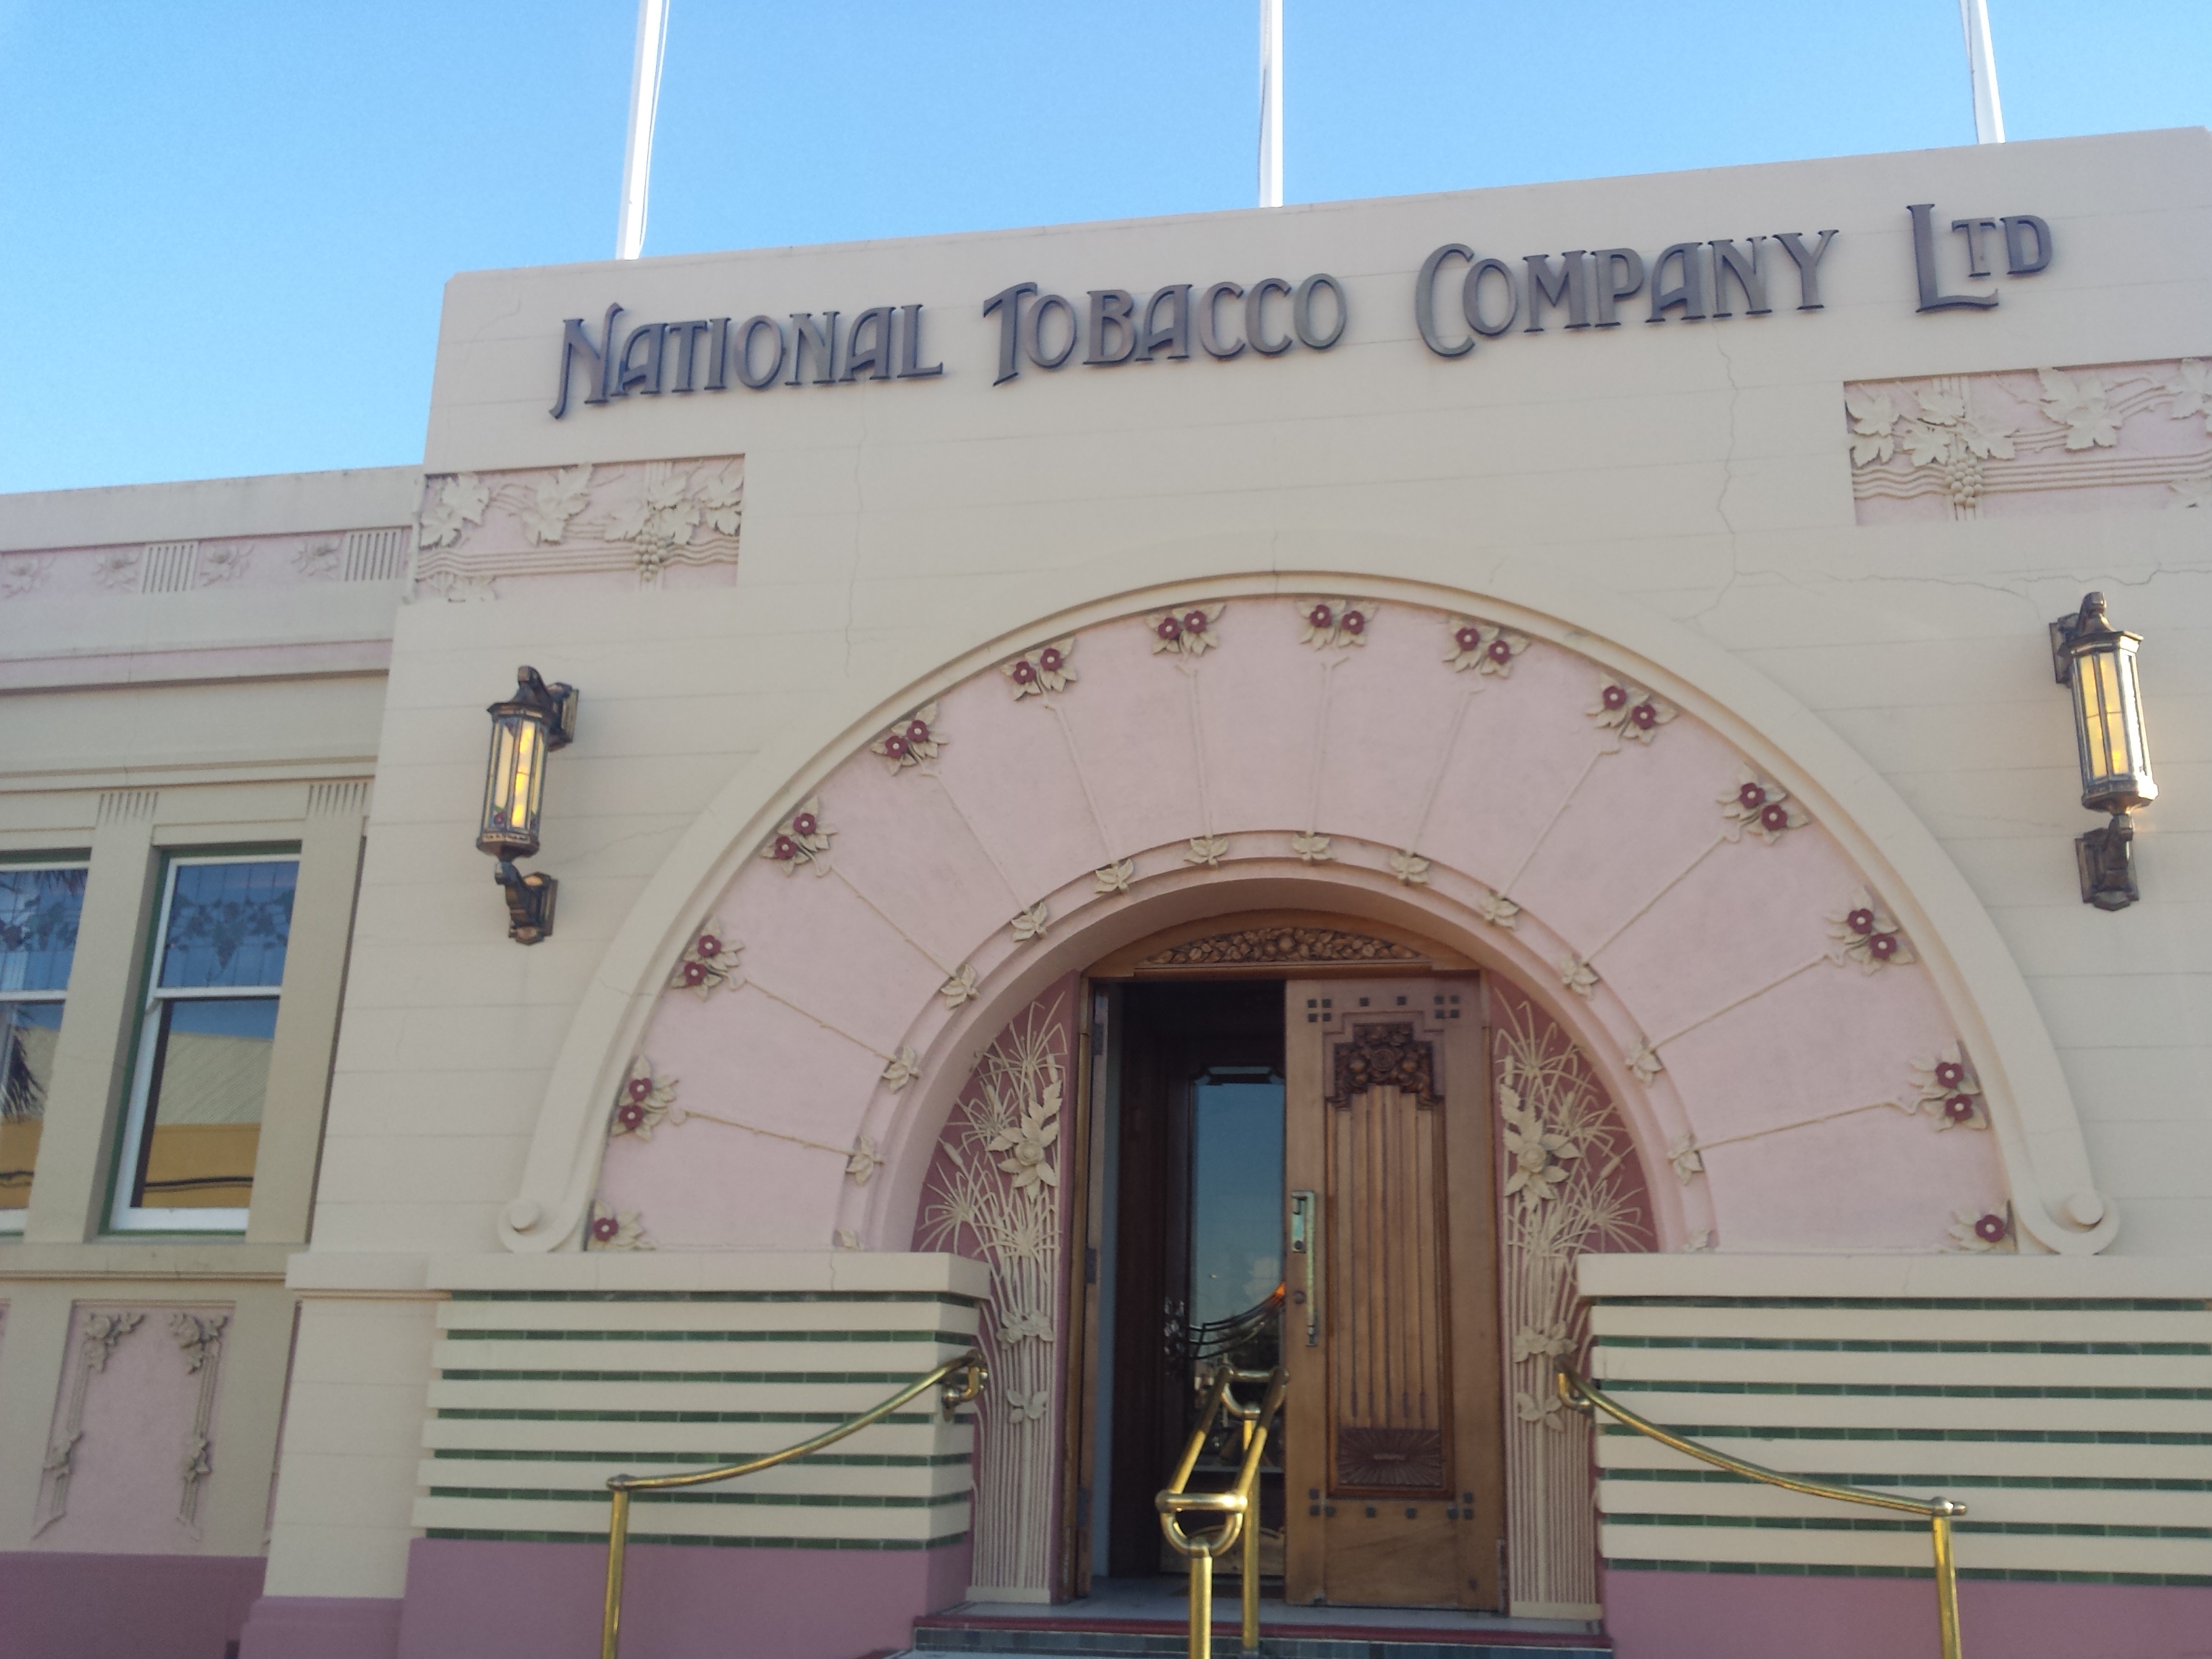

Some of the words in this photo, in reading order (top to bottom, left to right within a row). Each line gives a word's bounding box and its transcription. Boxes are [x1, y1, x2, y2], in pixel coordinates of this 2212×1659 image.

[549, 303, 943, 419] NATIONAL
[983, 273, 1348, 388] TOBACCO
[1415, 229, 1839, 358] COMPANY
[1906, 203, 2053, 312] LTD
